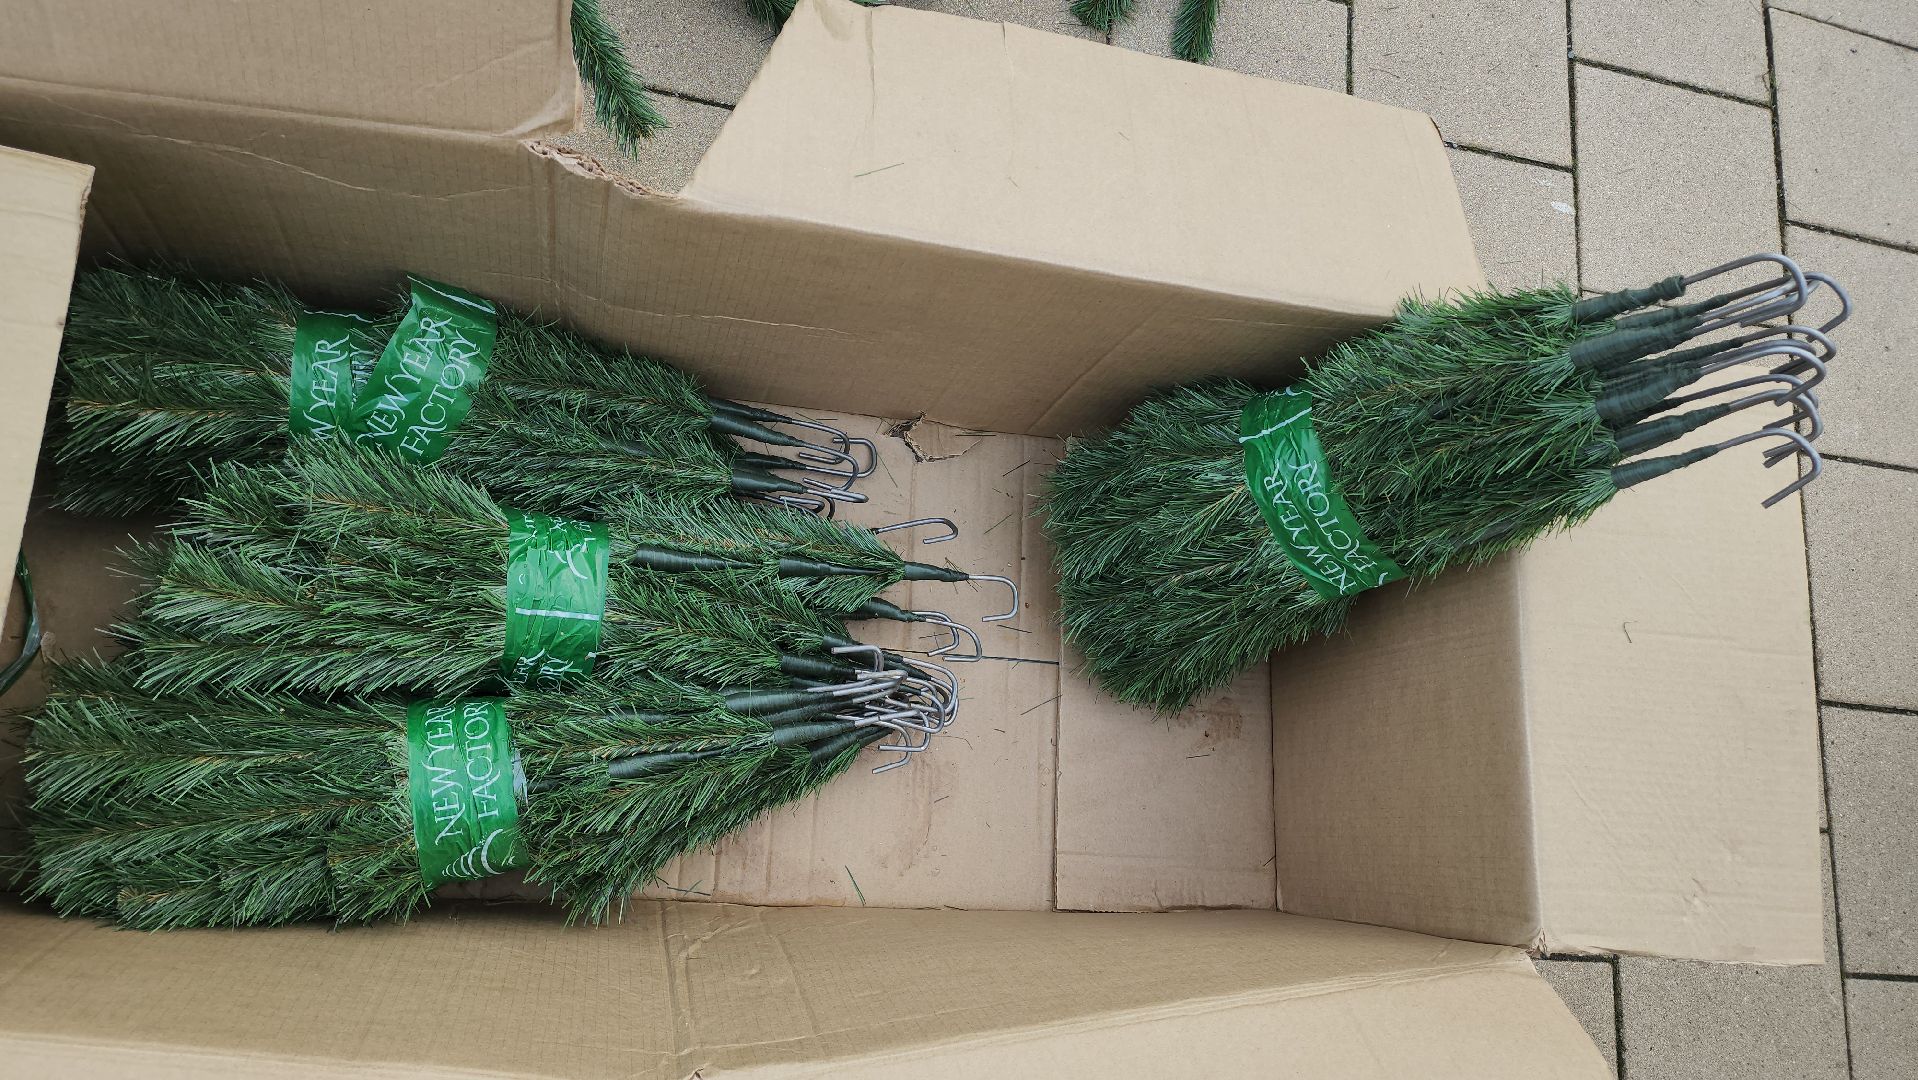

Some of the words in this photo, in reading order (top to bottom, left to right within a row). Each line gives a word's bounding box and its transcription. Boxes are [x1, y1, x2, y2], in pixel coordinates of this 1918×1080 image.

[310, 334, 350, 412] YEAR
[391, 317, 452, 384] YEAR
[400, 329, 480, 456] FACTORY
[1264, 459, 1308, 542] YEAR
[1287, 459, 1377, 573] FACTORY
[1290, 541, 1357, 595] NEW
[425, 701, 456, 763] YEAR
[422, 761, 466, 845] NEW
